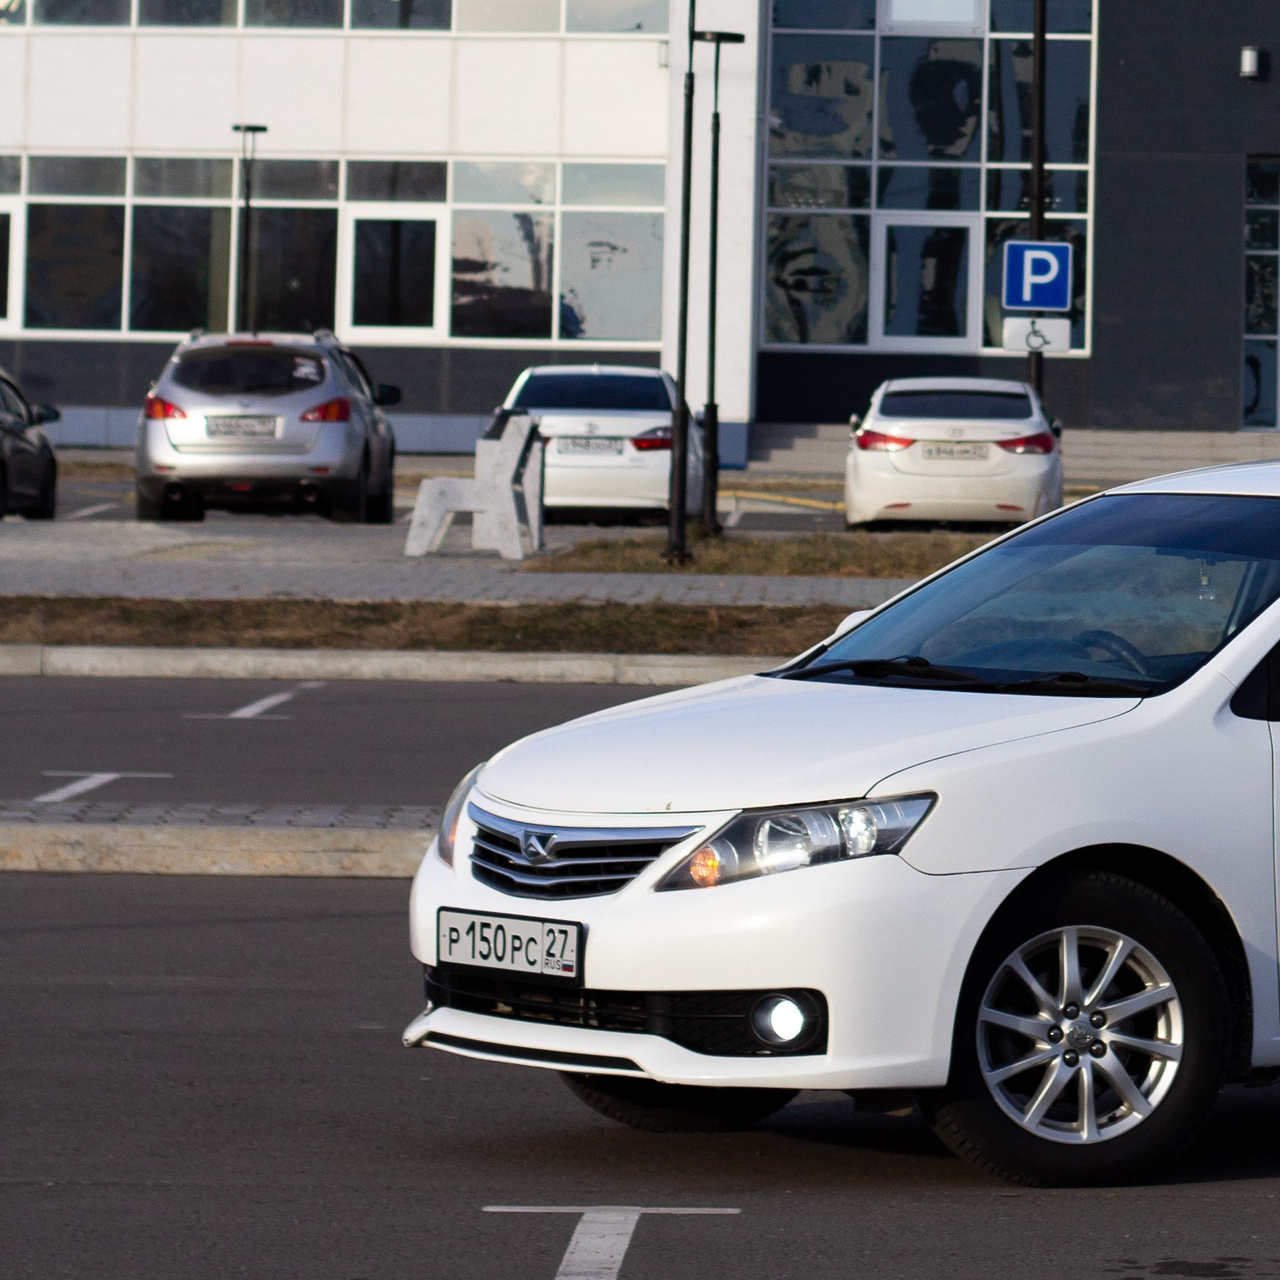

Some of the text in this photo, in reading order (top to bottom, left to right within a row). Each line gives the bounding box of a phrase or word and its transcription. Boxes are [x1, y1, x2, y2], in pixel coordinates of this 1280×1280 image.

[1022, 249, 1060, 302] P
[545, 927, 569, 959] 27
[544, 958, 561, 971] RUS
